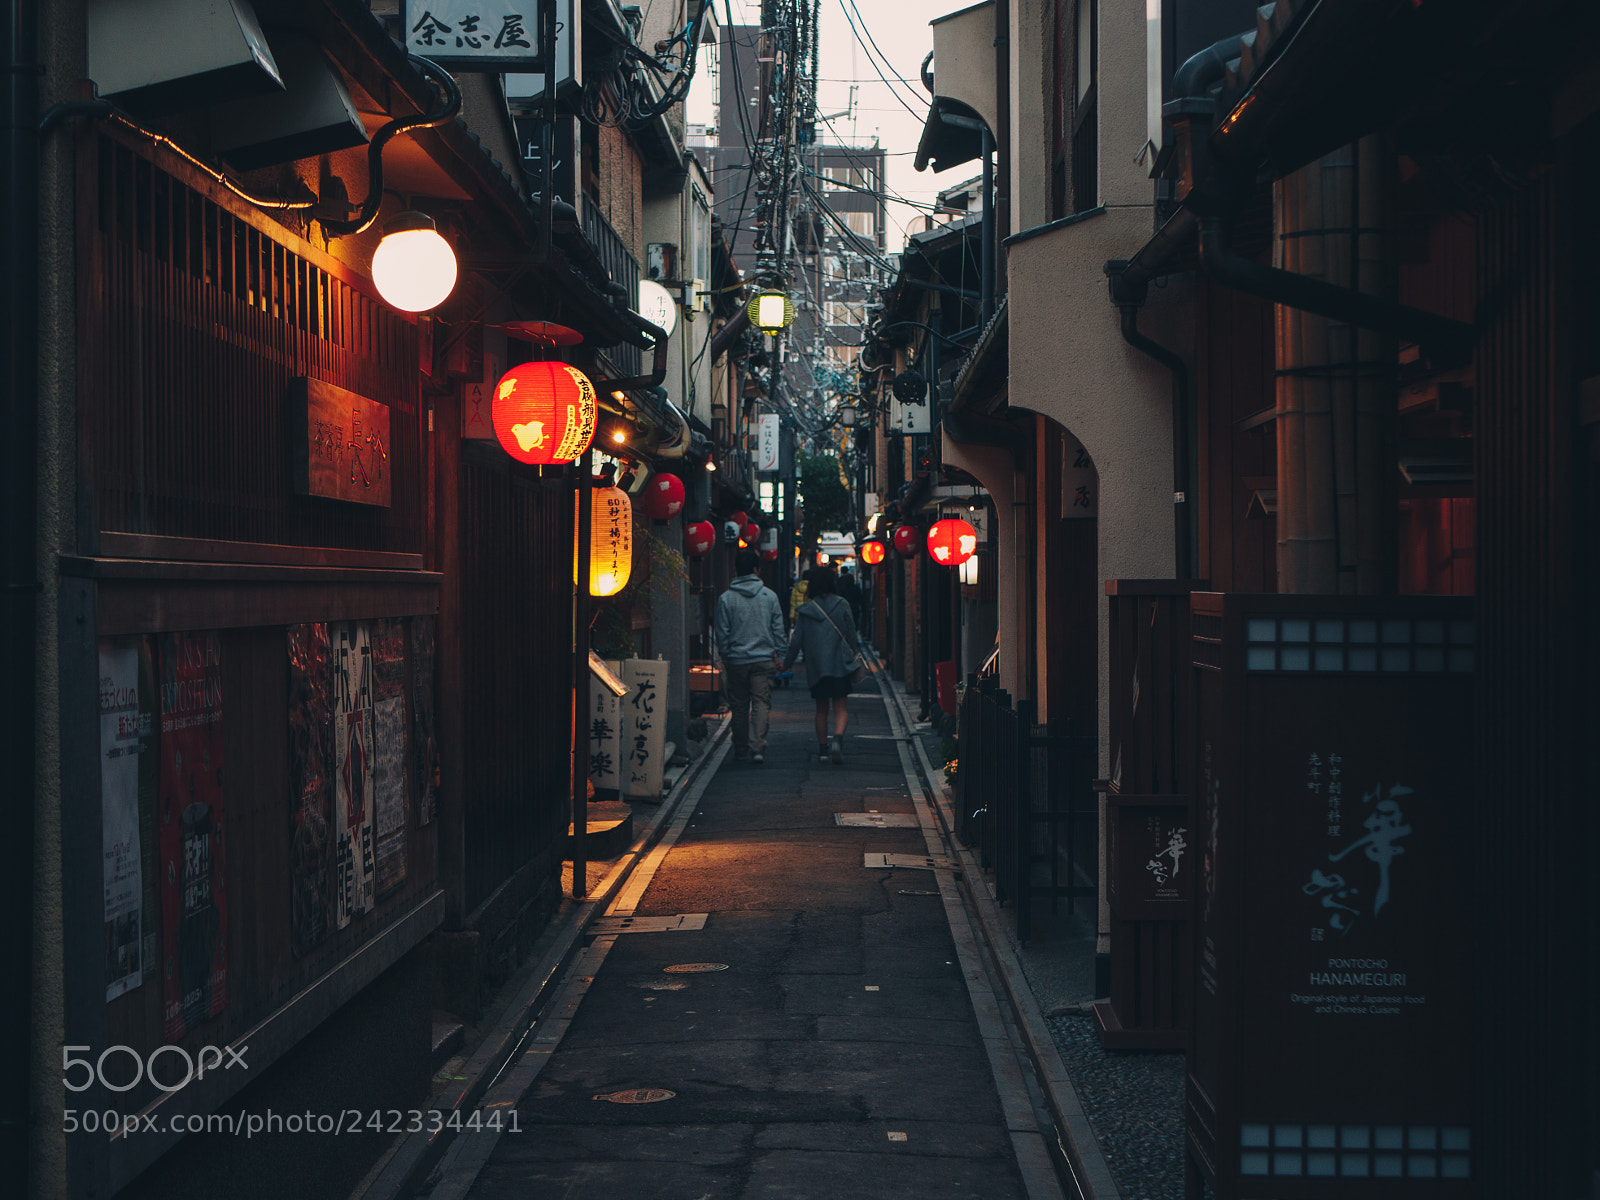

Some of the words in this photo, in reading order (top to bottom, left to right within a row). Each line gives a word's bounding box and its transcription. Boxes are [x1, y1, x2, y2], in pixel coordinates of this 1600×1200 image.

[412, 11, 531, 49] 余志屋
[1306, 752, 1323, 794] 先斗町
[1328, 958, 1389, 969] PONTOCHO
[1309, 972, 1407, 987] HANAMEGURI
